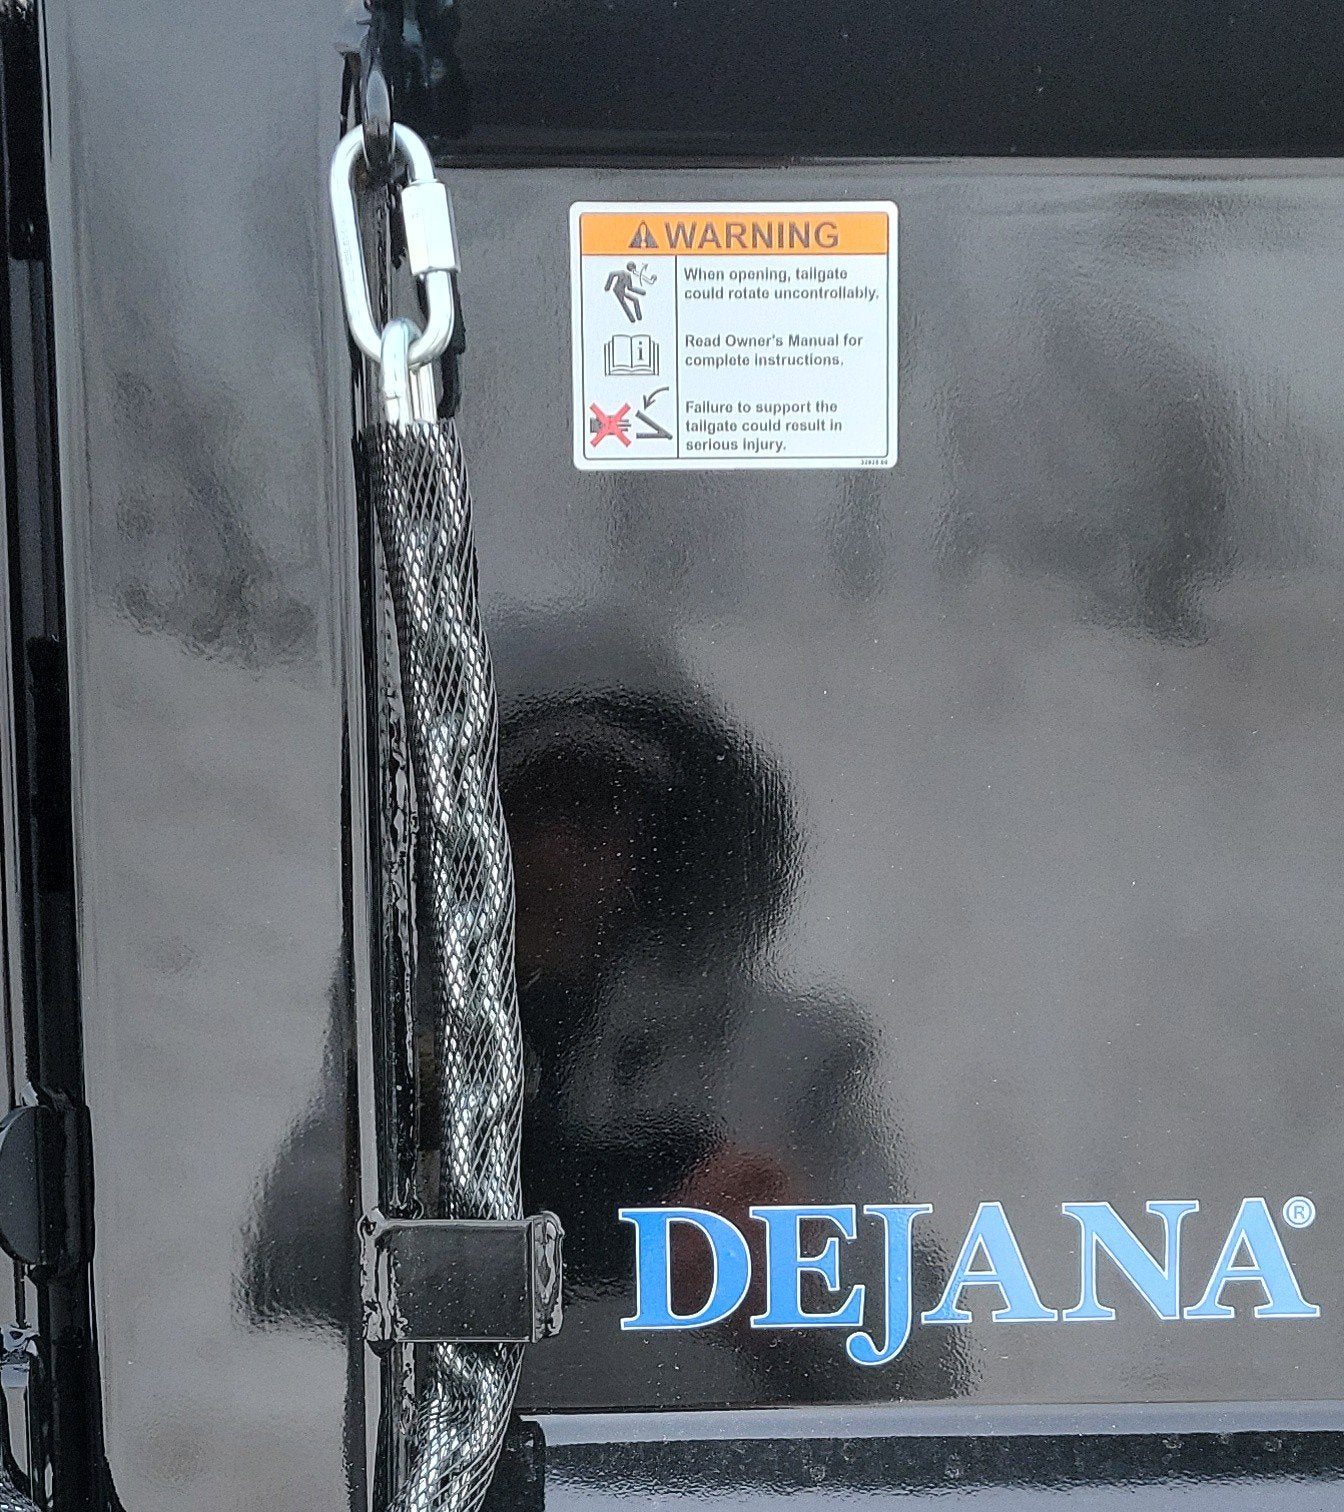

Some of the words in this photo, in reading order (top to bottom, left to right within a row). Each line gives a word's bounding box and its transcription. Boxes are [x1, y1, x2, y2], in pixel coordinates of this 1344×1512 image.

[665, 222, 840, 249] WARNING
[684, 267, 724, 281] When
[729, 267, 791, 284] opening,
[795, 266, 848, 283] tailgate
[684, 286, 724, 300] could
[728, 286, 770, 300] rotate
[774, 285, 880, 303] uncontrollably.
[685, 334, 721, 348] Read
[725, 334, 784, 348] Owner's
[788, 333, 839, 347] Manual
[843, 333, 864, 347] for
[685, 353, 750, 370] complete
[754, 353, 844, 367] instructions.
[685, 400, 733, 414] Failure
[737, 401, 752, 414] to
[756, 400, 811, 416] support
[815, 400, 838, 413] the
[685, 419, 738, 435] tailgate
[741, 419, 781, 432] could
[785, 418, 826, 432] result
[830, 418, 843, 432] in
[686, 438, 739, 451] serious
[742, 437, 787, 454] injury.
